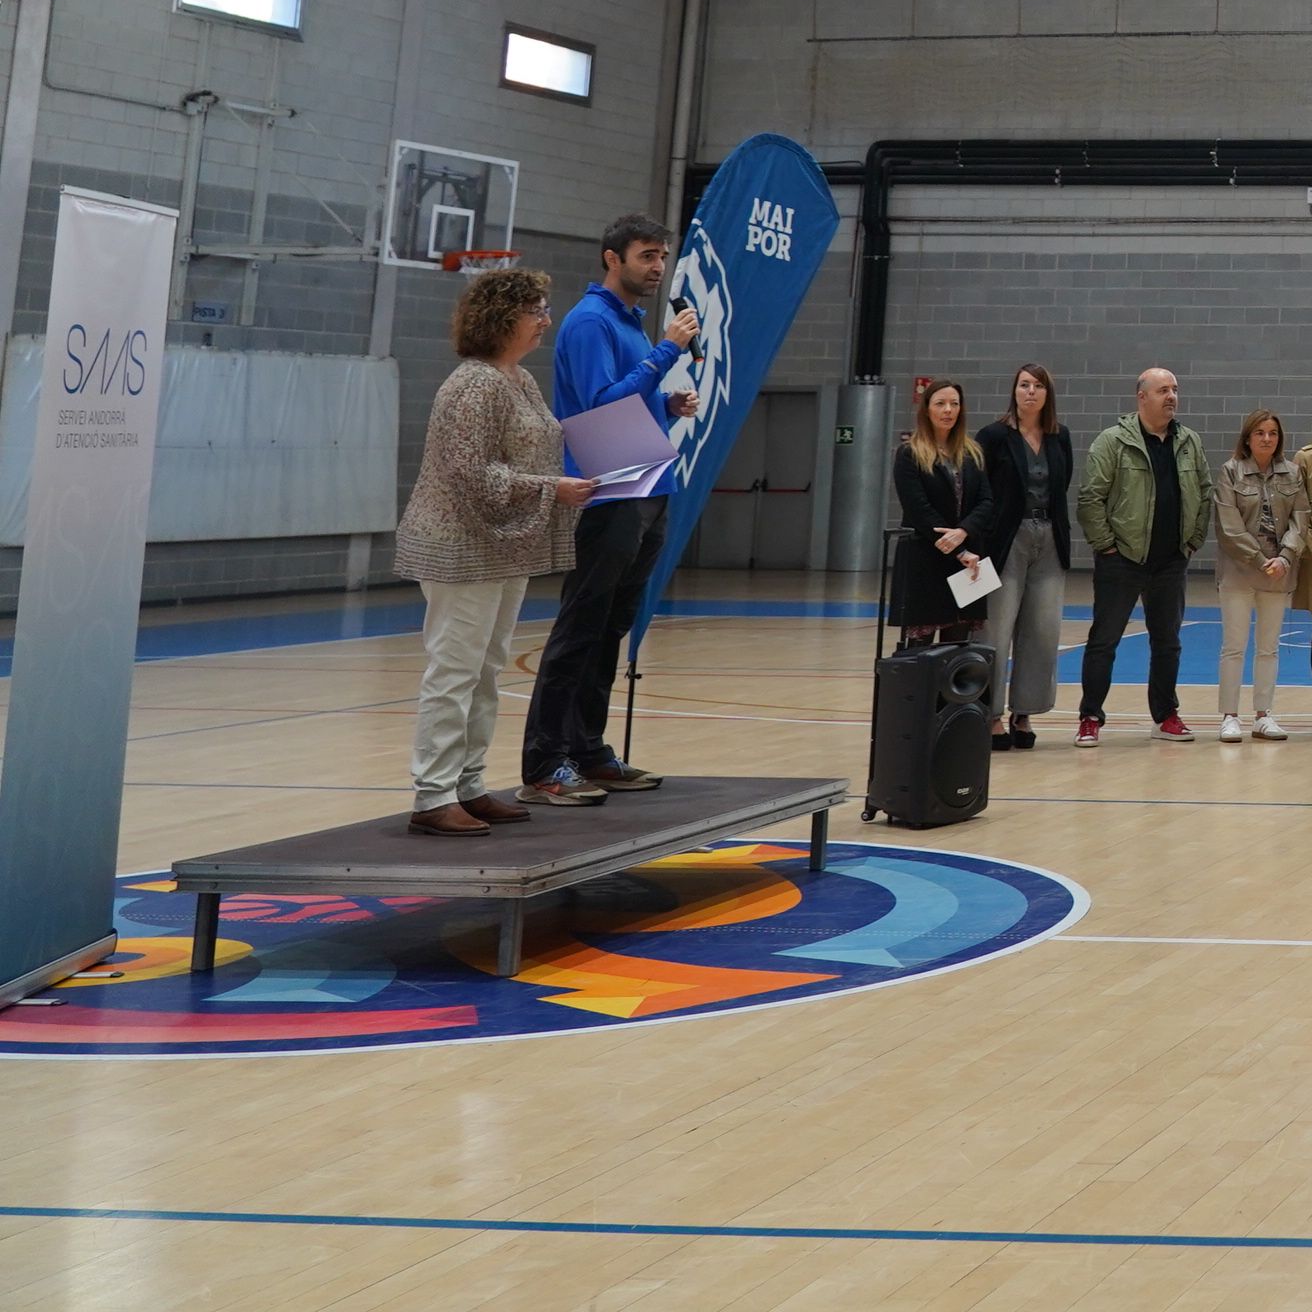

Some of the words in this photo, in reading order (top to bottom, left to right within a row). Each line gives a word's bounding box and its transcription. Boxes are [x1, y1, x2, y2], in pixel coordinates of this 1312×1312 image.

[749, 197, 795, 234] MAI
[745, 225, 791, 261] POR
[59, 409, 86, 425] SERVEI
